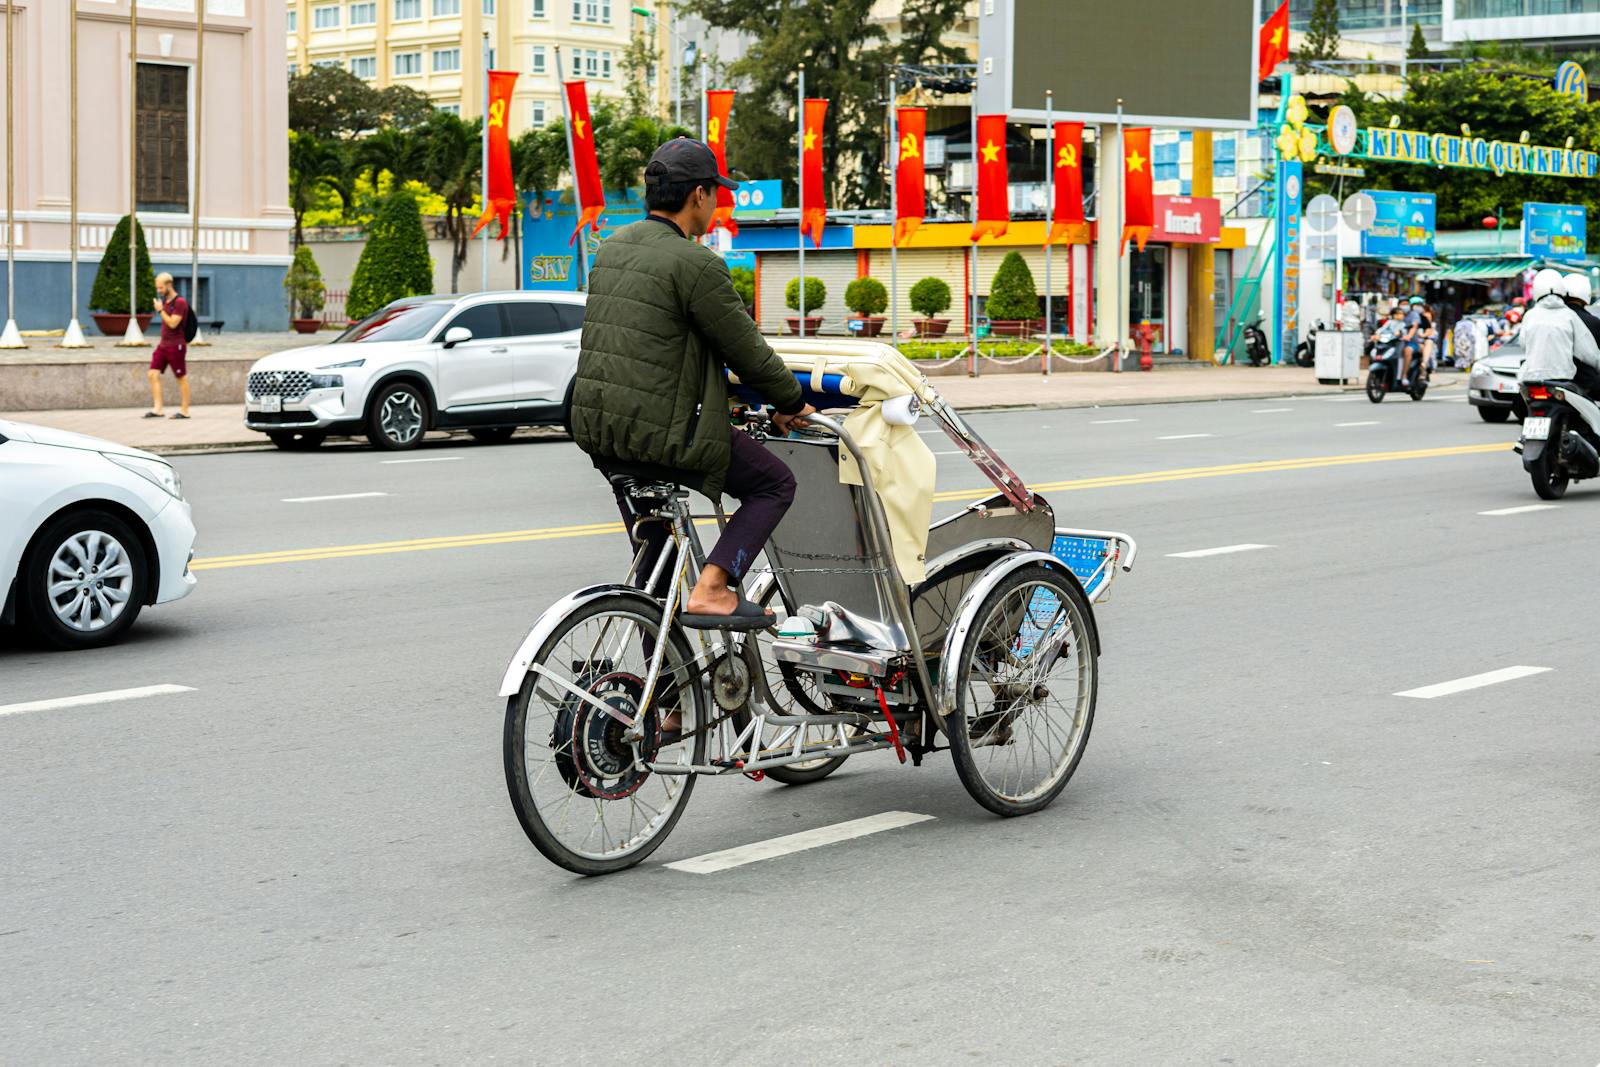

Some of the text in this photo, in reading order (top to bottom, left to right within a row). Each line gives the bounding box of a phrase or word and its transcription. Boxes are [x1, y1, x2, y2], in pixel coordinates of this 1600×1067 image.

[1368, 115, 1597, 178] KÍNH CHÀO QUÝ KHÁCH
